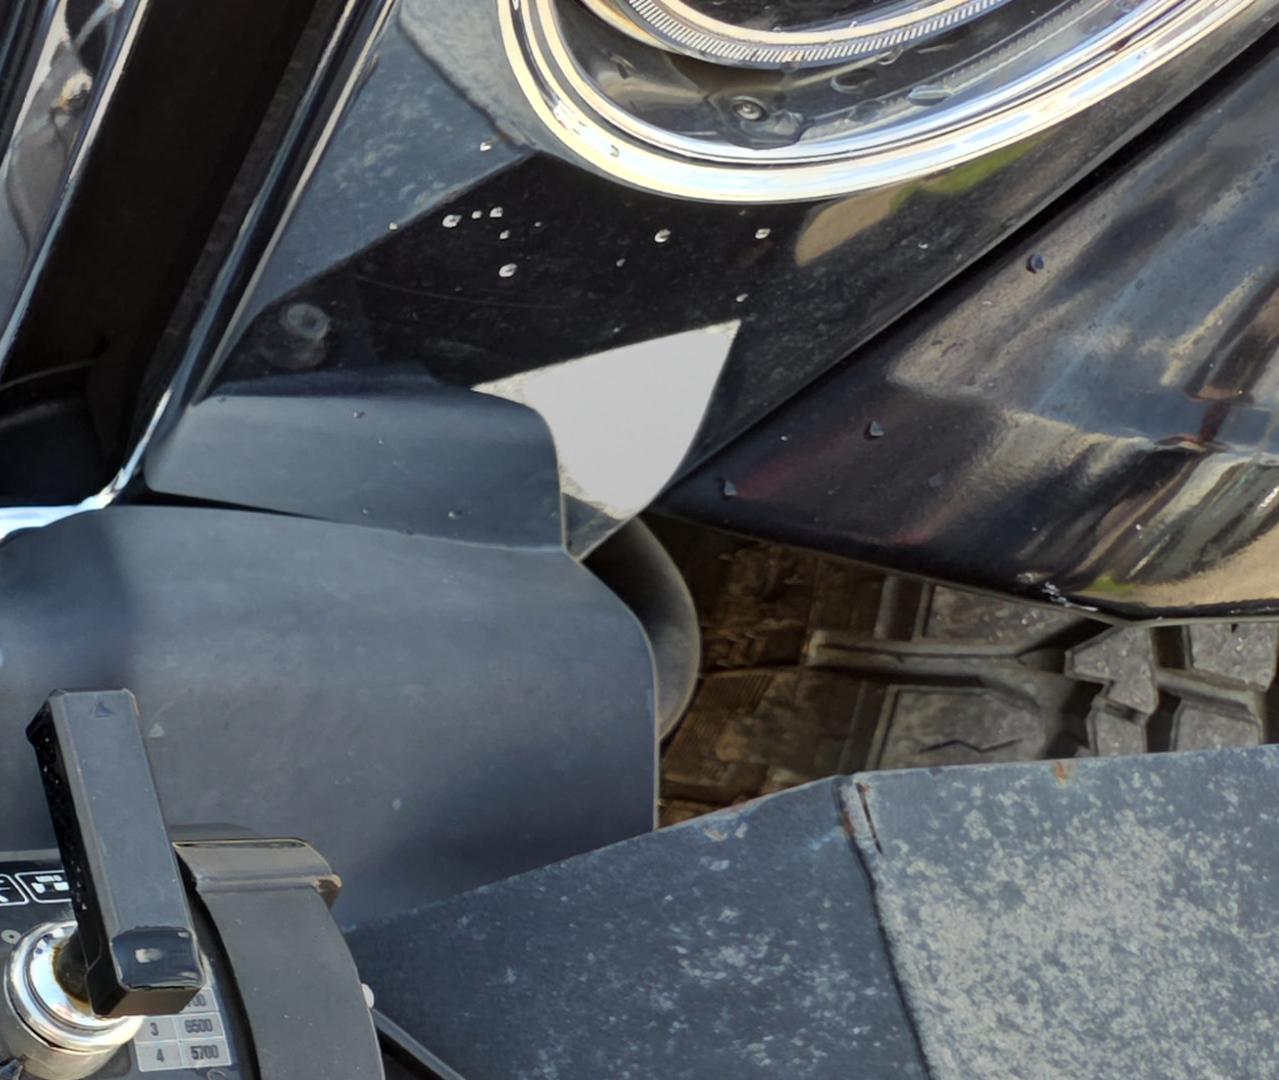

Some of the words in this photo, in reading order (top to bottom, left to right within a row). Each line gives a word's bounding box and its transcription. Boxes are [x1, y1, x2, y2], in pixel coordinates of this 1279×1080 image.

[149, 1021, 159, 1036] 3
[184, 1018, 213, 1034] 6500
[155, 1047, 165, 1063] 4
[190, 1044, 219, 1060] 5700
